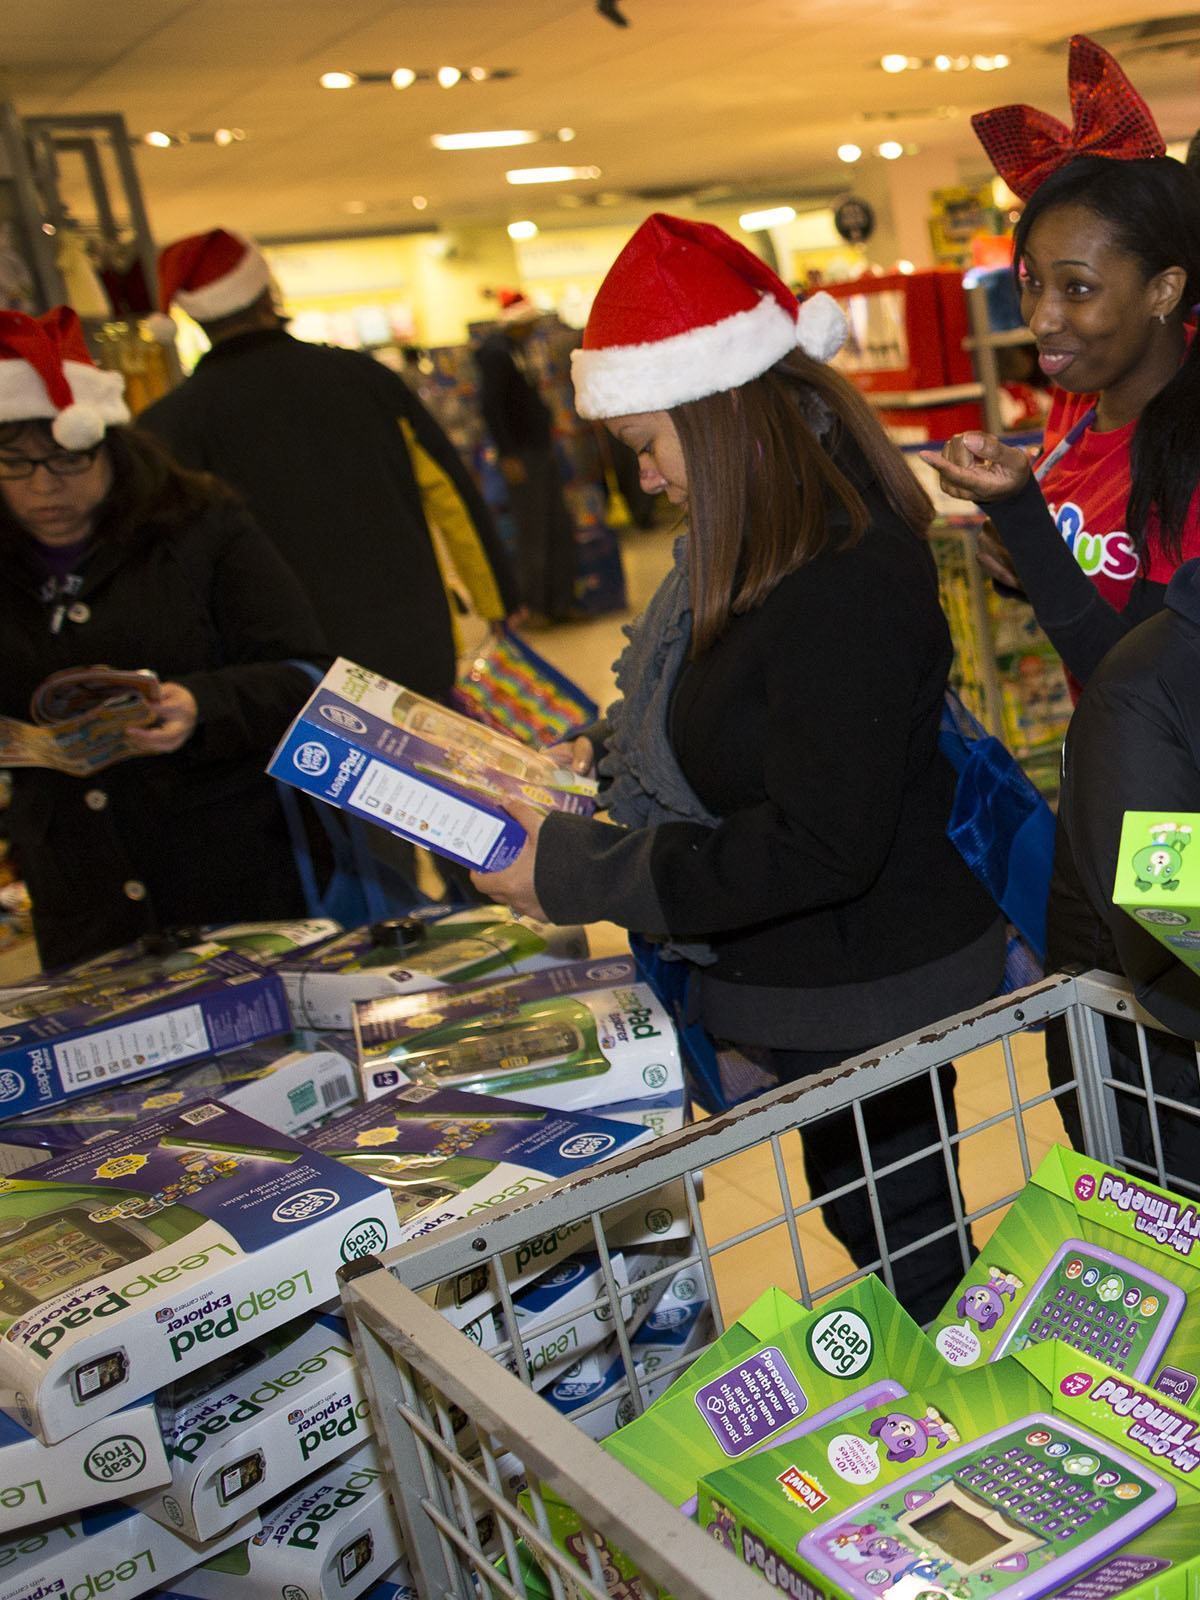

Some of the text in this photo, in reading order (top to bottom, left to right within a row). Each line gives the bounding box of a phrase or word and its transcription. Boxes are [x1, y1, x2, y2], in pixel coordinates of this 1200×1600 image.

[324, 747, 362, 798] LeapPad
[27, 1048, 53, 1101] LeapPad
[218, 1164, 310, 1208] Child-friendly tablet.
[240, 1170, 322, 1211] Limitless learning.
[261, 1168, 316, 1197] Endless play.
[1077, 1184, 1092, 1198] 2+
[278, 1193, 320, 1216] Frog
[294, 1194, 335, 1219] Leap
[346, 1224, 378, 1249] Frog
[1135, 1215, 1193, 1254] My Own
[22, 1284, 111, 1345] Explorer
[28, 1243, 237, 1361] LeapPad
[166, 1293, 233, 1334] Explorer
[169, 1269, 314, 1363] LeapPad
[173, 1289, 215, 1314] with camera
[815, 1328, 858, 1374] Frog
[827, 1313, 869, 1356] Leap
[943, 1339, 969, 1357] stories
[739, 1369, 776, 1427] child's name
[754, 1368, 784, 1412] with your
[759, 1350, 800, 1415] Personalize
[1064, 1379, 1080, 1394] 2+
[1072, 1374, 1090, 1386] years
[164, 1345, 353, 1465] LeapPad
[297, 1393, 352, 1434] Explorer
[719, 1383, 755, 1437] things they
[734, 1386, 759, 1422] and the
[719, 1414, 743, 1444] most!
[1129, 1423, 1200, 1473] My Own
[91, 1441, 133, 1468] Frog
[101, 1451, 141, 1478] Leap
[834, 1456, 849, 1472] 10+
[838, 1446, 862, 1475] stories
[783, 1472, 822, 1508] New!
[272, 1485, 335, 1545] Explorer
